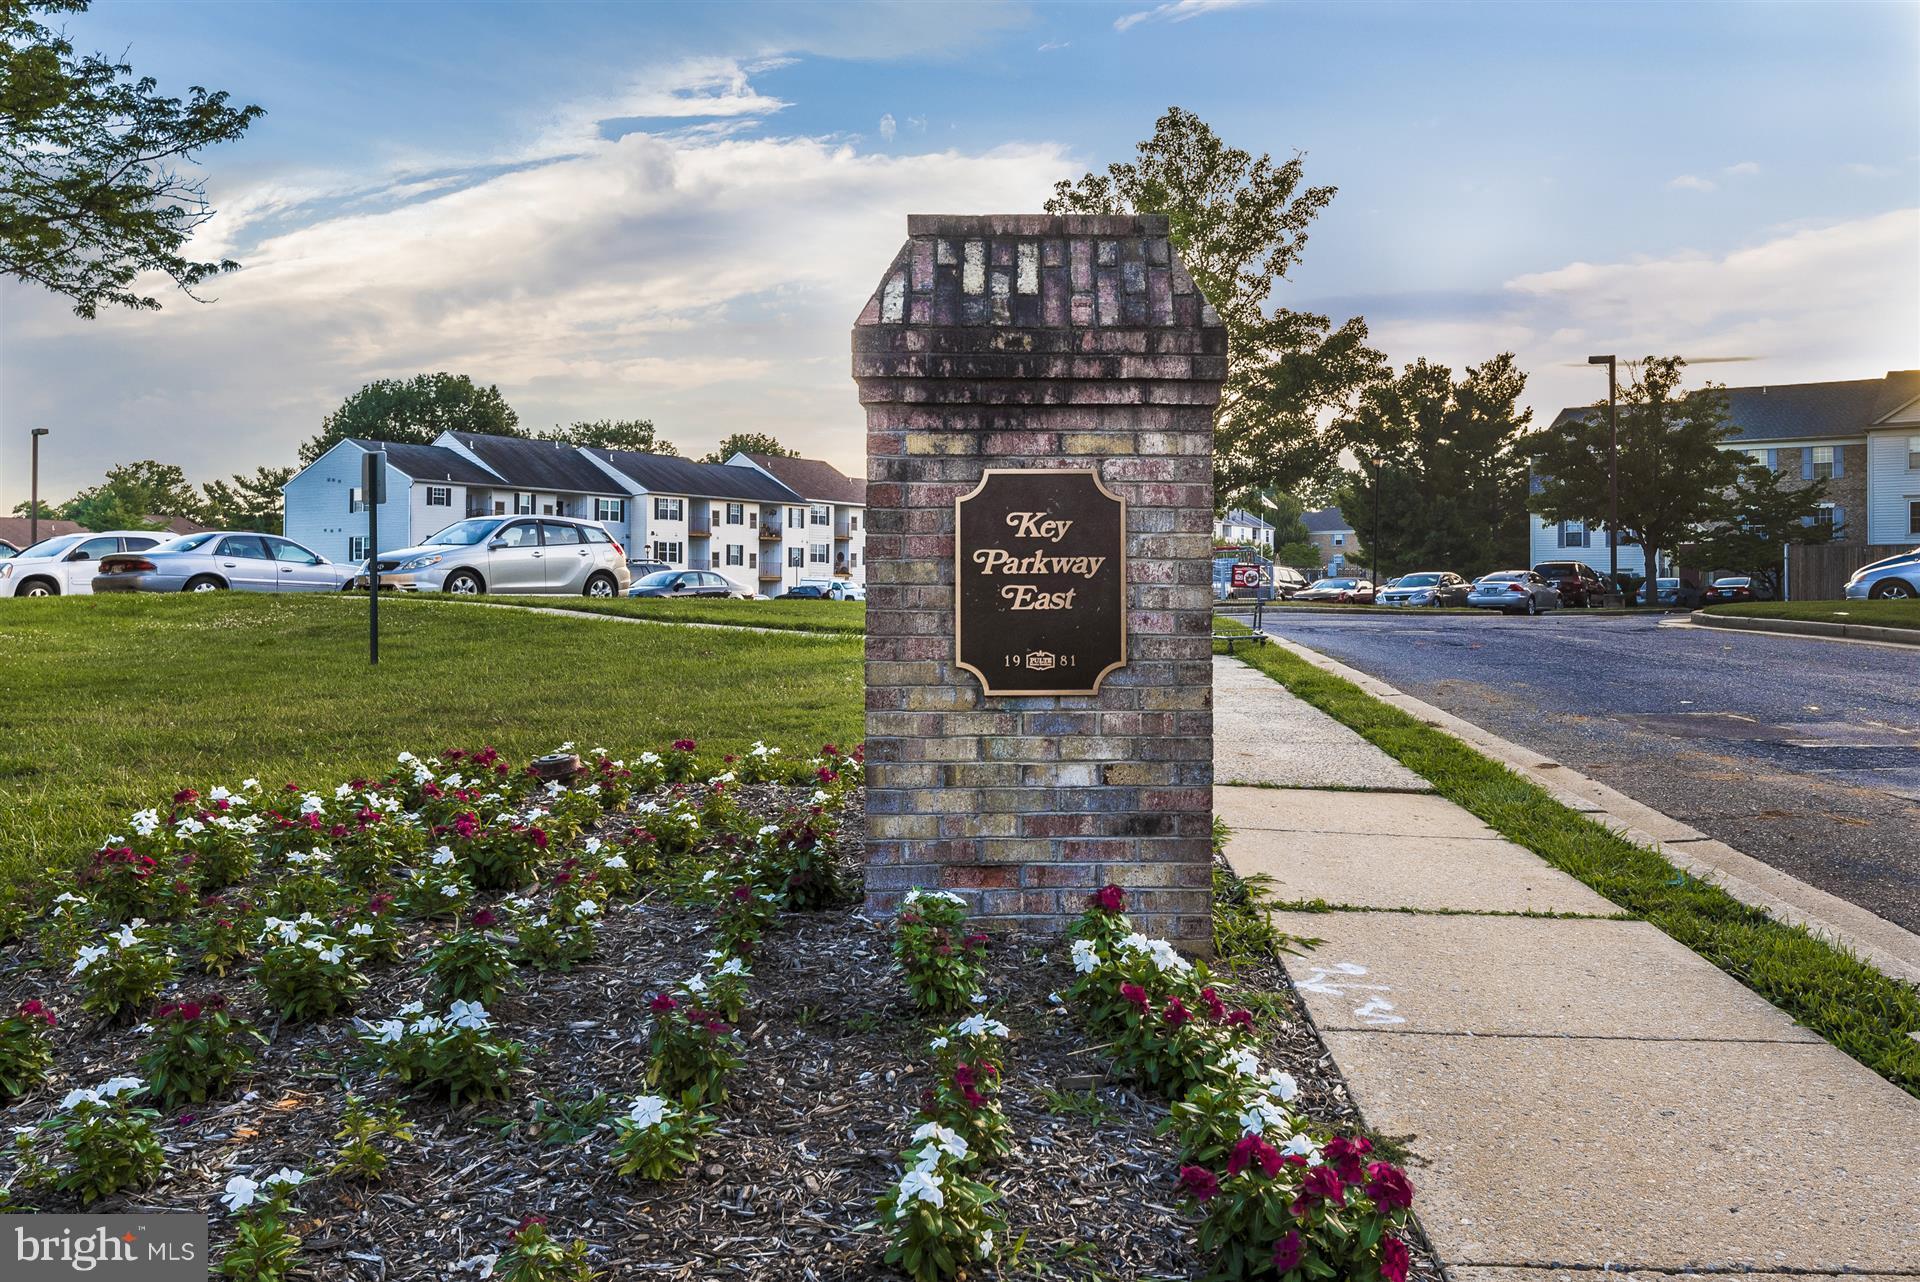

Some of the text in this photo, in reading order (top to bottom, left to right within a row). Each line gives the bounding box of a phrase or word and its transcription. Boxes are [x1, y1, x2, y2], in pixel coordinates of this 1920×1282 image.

[1006, 511, 1073, 542] Key
[973, 549, 1106, 579] Parkway
[1001, 585, 1076, 610] East
[1004, 655, 1021, 667] 19
[1060, 655, 1076, 667] 81
